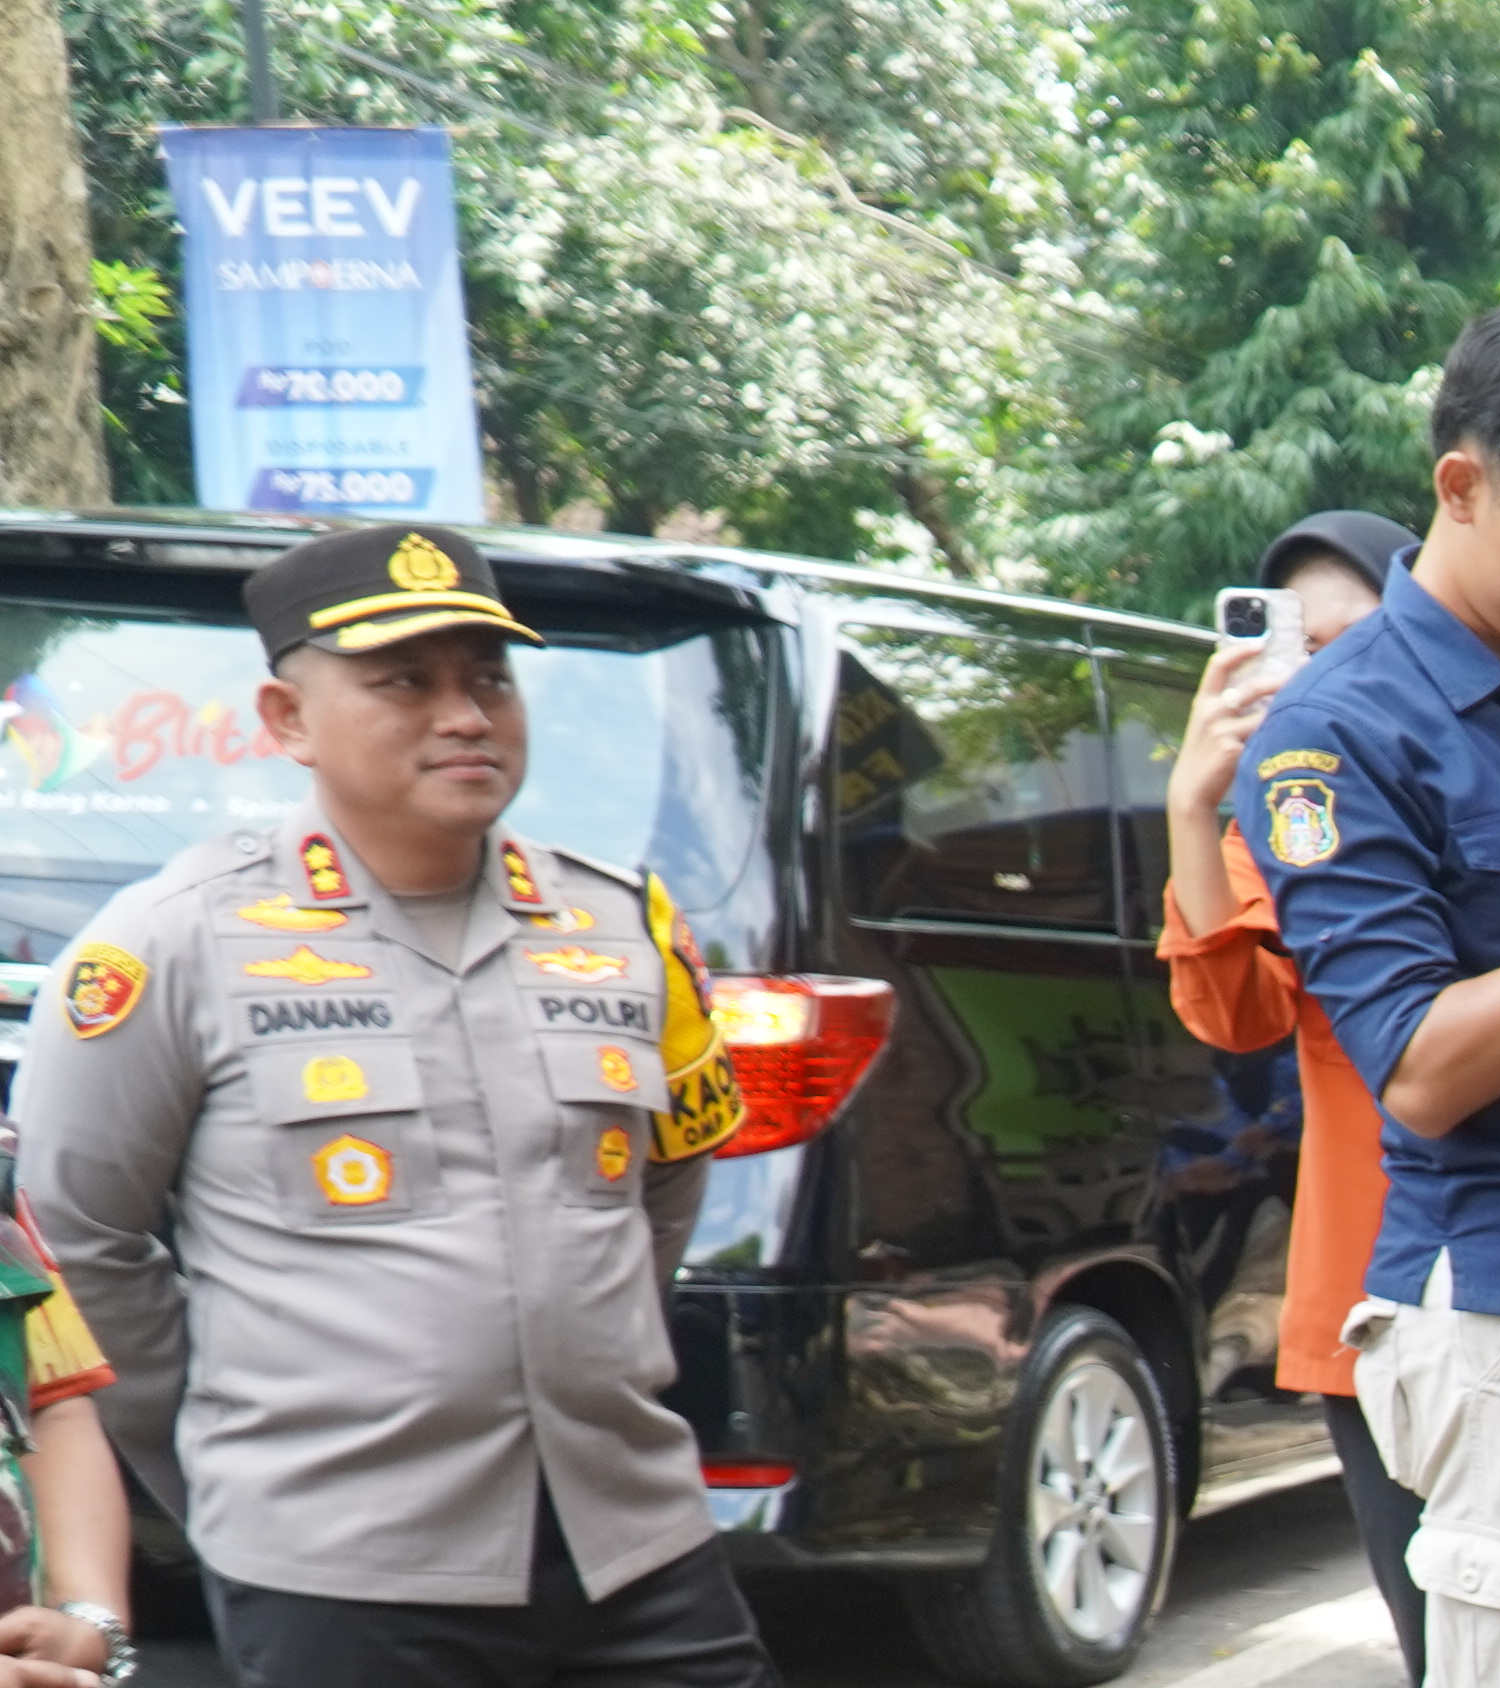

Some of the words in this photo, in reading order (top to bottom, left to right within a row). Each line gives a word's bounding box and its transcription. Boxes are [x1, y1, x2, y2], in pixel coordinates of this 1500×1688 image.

[202, 176, 423, 238] VEEV
[215, 259, 424, 291] SAMPOERNA
[249, 997, 393, 1036] DANANG
[540, 994, 649, 1032] POLRI
